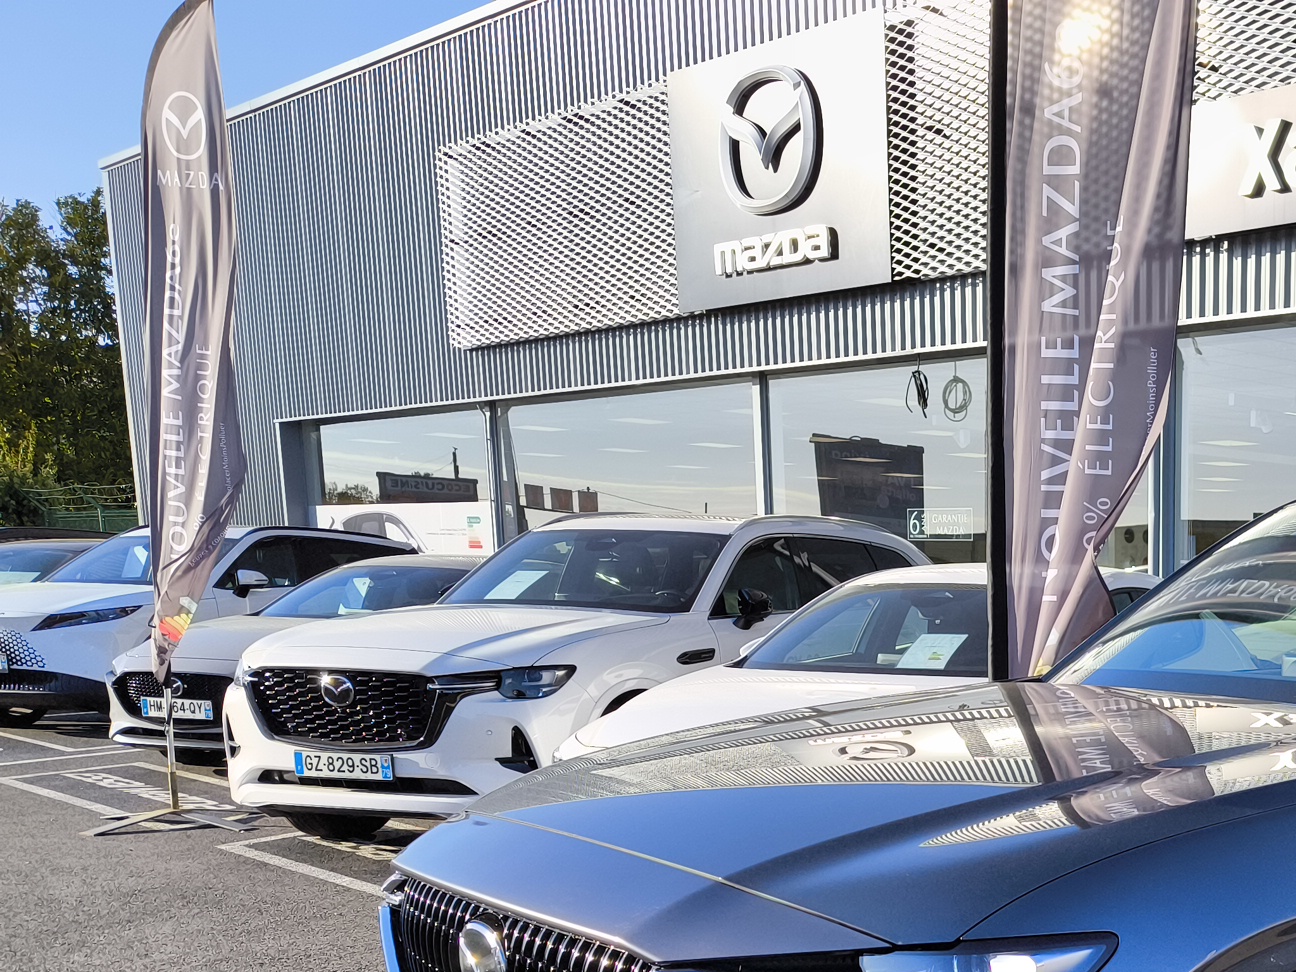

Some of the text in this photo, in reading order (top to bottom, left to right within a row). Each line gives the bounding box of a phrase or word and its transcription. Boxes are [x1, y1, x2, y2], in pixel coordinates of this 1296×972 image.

[1040, 18, 1084, 316] MAZDA6
[157, 169, 224, 191] MAZDA
[162, 410, 190, 562] OUVELLE
[909, 511, 920, 535] 6
[931, 513, 968, 523] GARANTIE
[936, 525, 964, 535] MAZDA
[149, 700, 203, 715] HM-64-QY
[304, 754, 379, 775] GZ-829-SB
